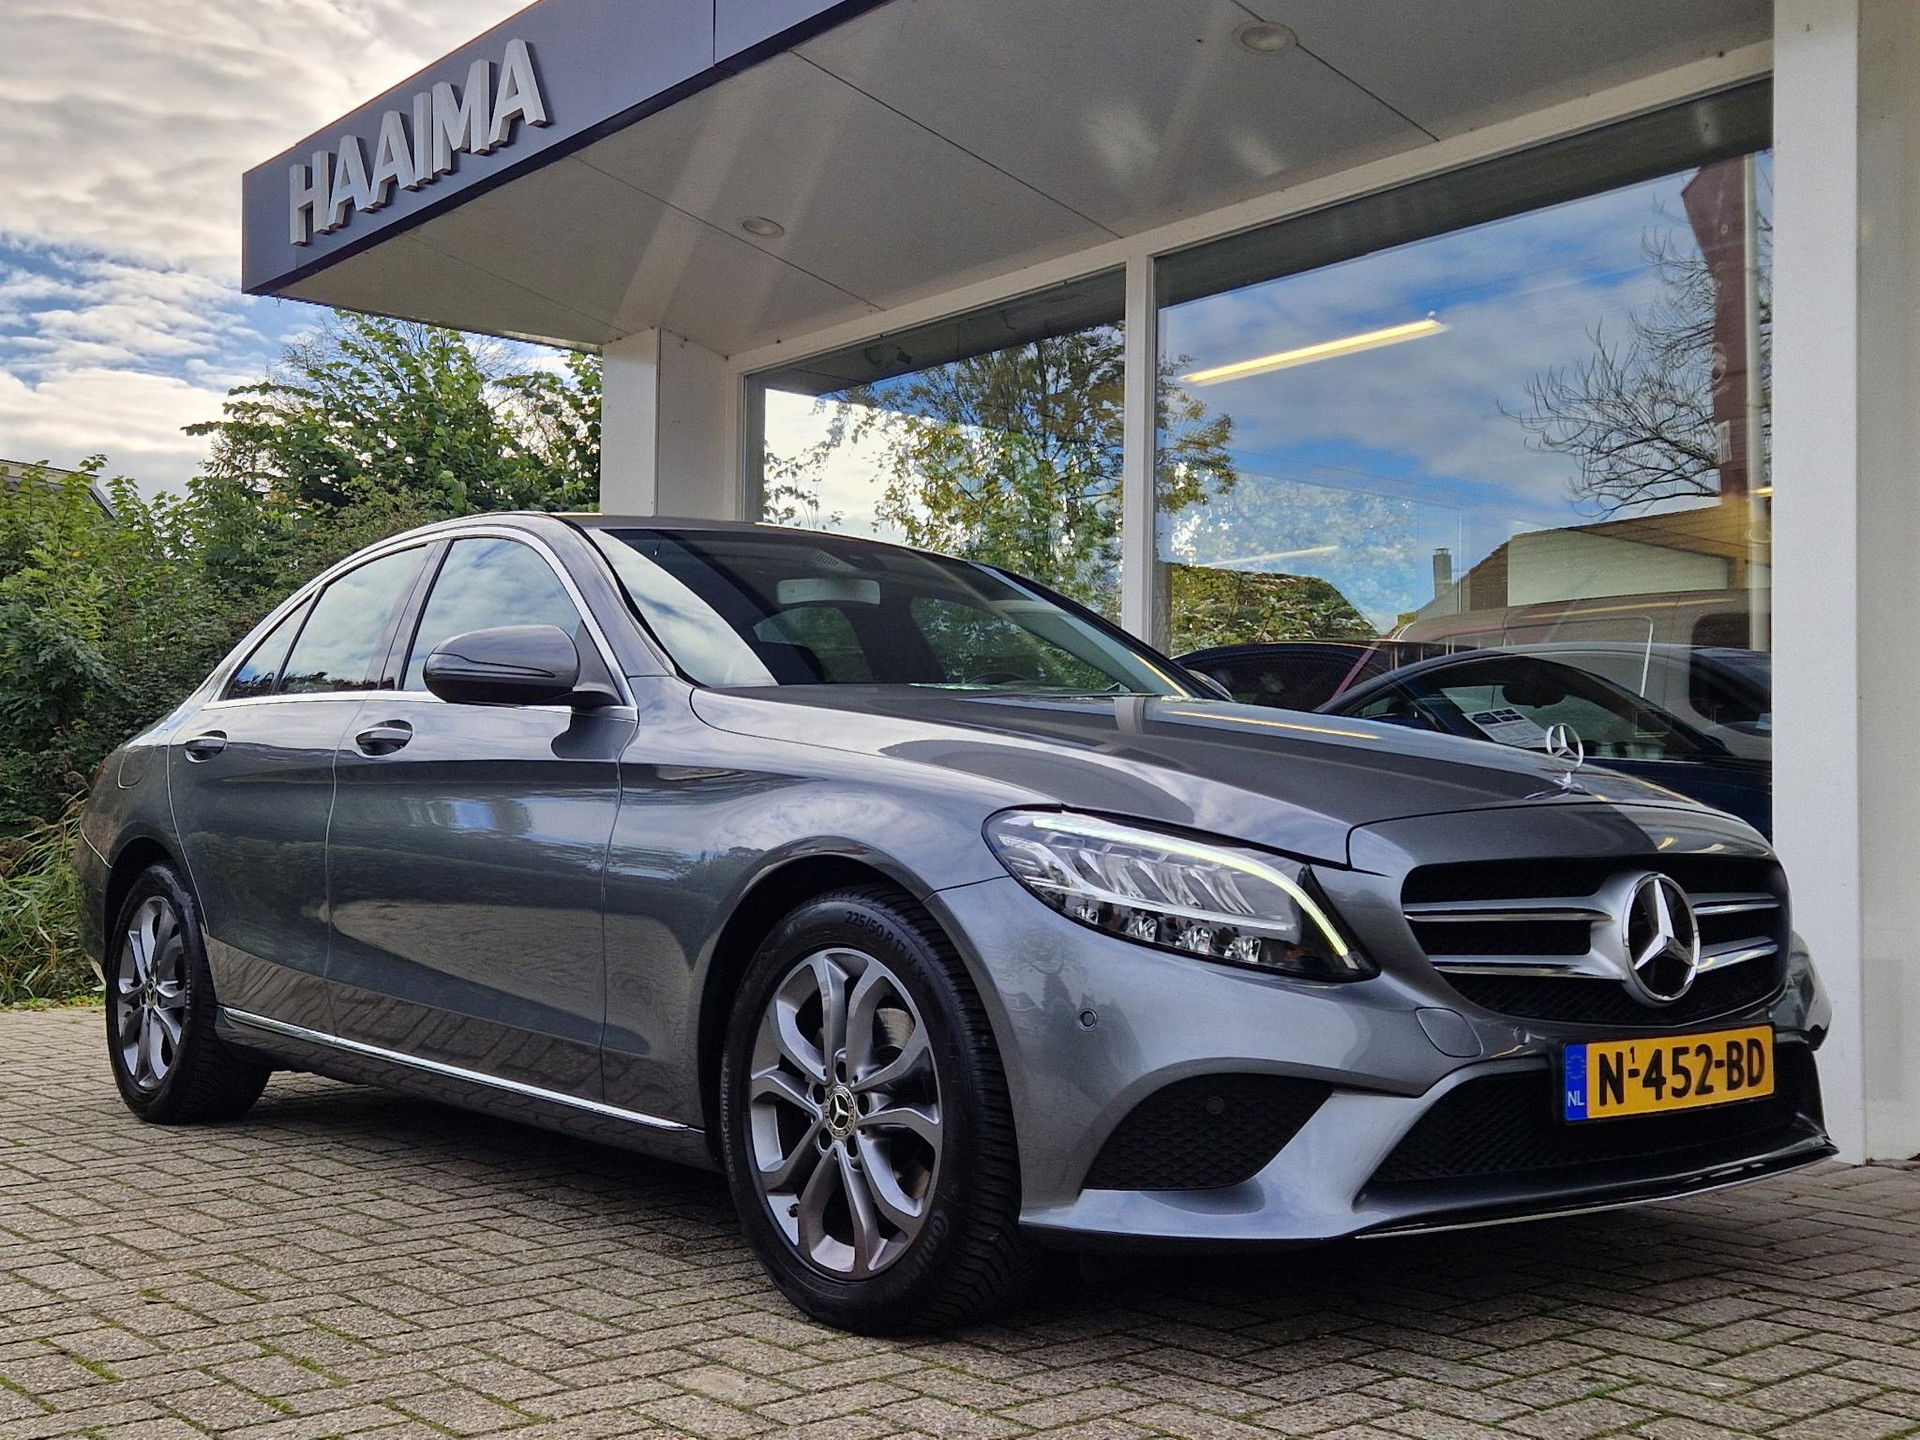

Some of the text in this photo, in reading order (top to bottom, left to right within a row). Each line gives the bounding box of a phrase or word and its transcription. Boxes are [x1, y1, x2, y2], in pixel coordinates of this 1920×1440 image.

[289, 38, 548, 246] HAAIMA
[846, 910, 885, 938] 225/50
[1567, 1091, 1585, 1107] NL
